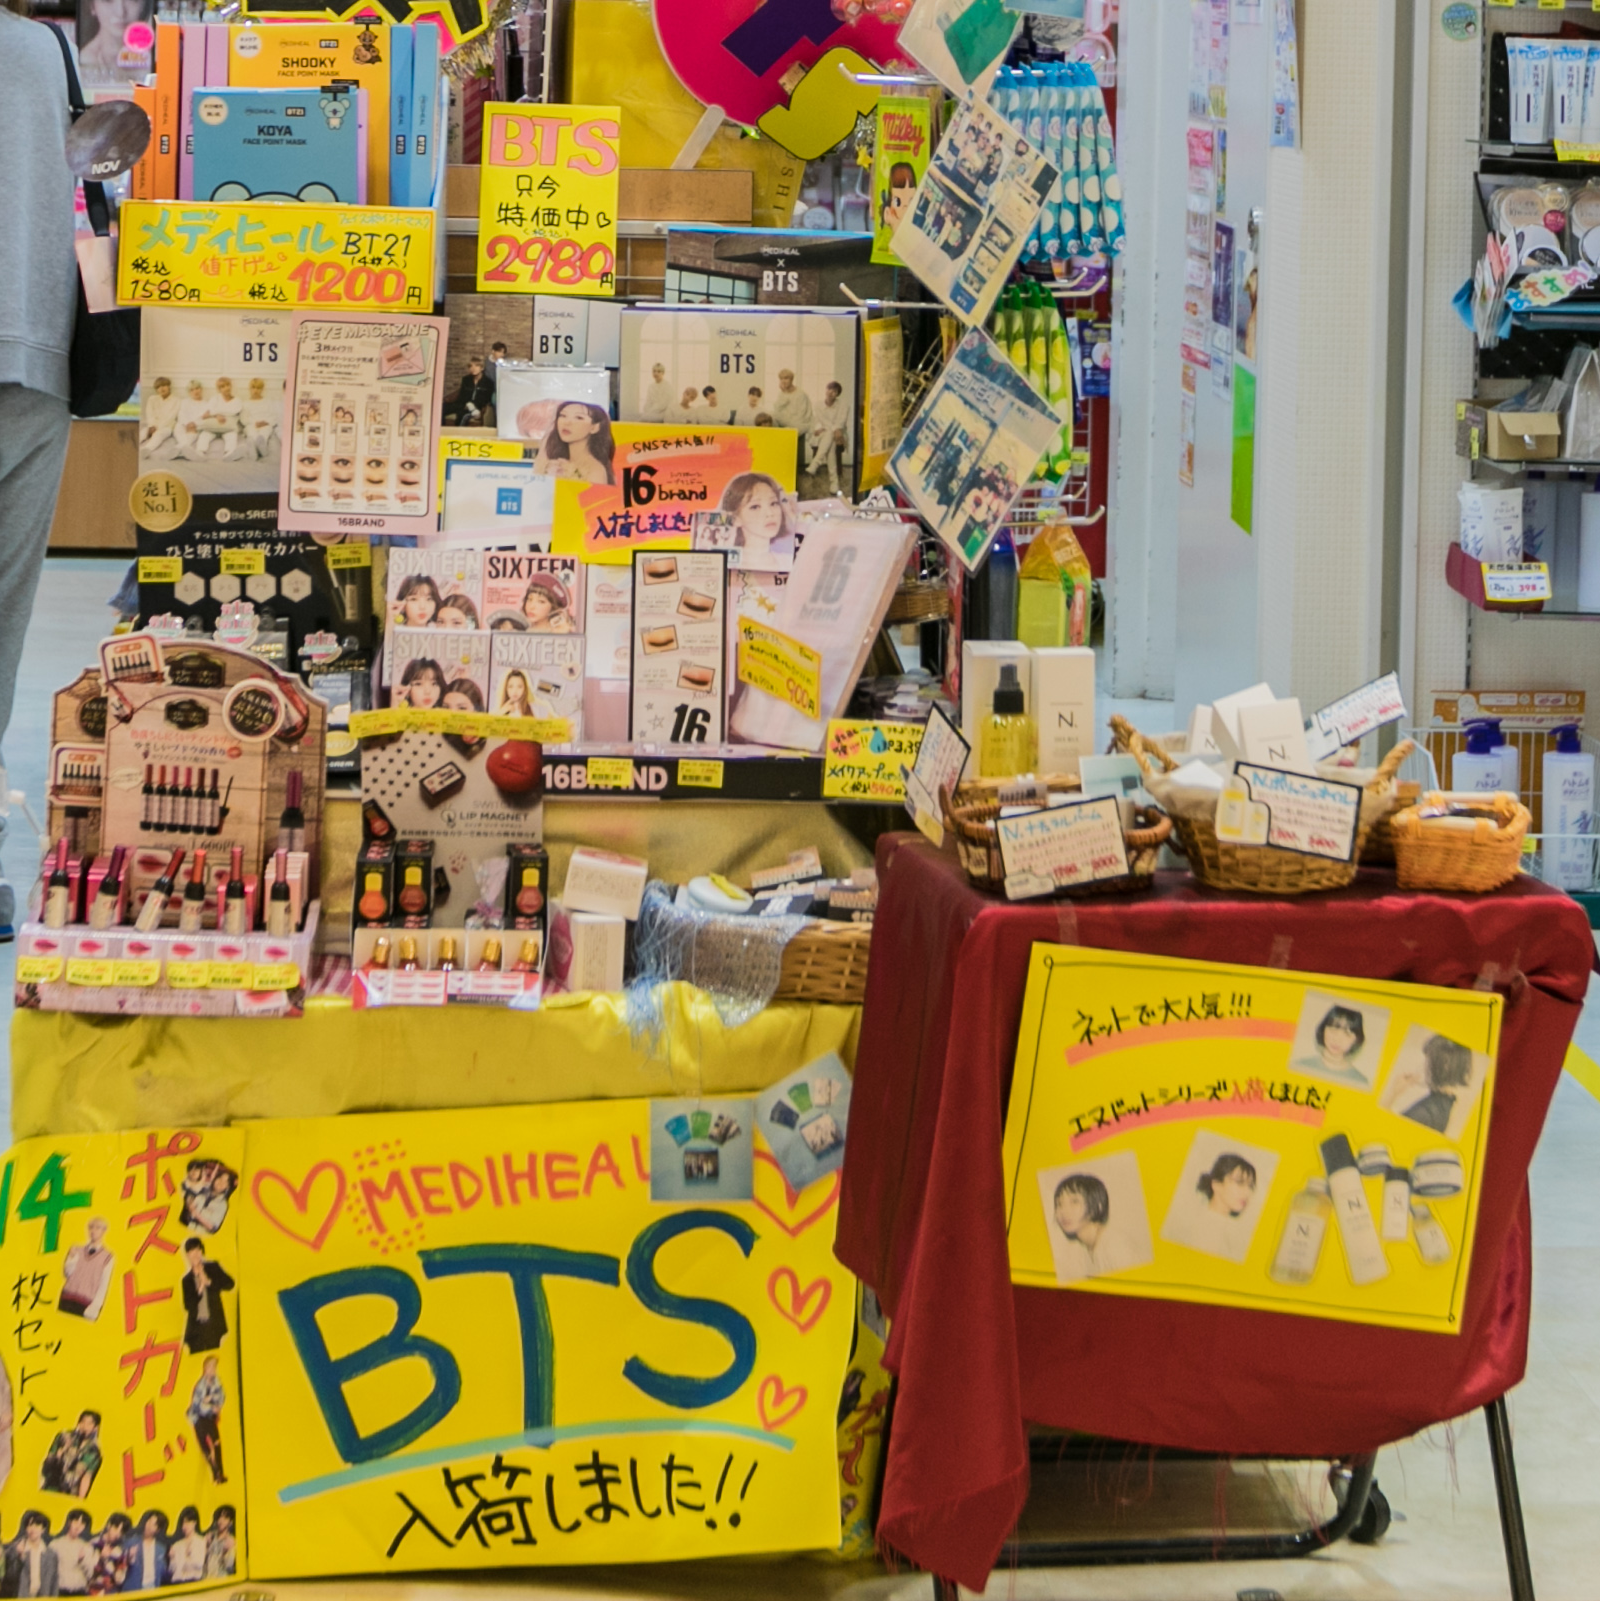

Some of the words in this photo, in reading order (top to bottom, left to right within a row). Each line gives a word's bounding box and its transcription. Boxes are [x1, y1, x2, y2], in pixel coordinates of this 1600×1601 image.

[281, 57, 337, 72] SHOOKY
[257, 125, 293, 138] KOYA
[882, 110, 924, 147] Milky
[488, 114, 620, 176] BTS
[515, 175, 560, 197] 只今
[497, 204, 593, 230] 特価中
[138, 210, 334, 254] メディヒール
[340, 232, 412, 257] BT21
[760, 246, 802, 257] MEDIHEAL
[131, 258, 171, 276] 税込
[130, 278, 201, 302] 1580円
[248, 282, 289, 303] 税込
[288, 261, 423, 305] 1200円
[762, 269, 799, 294] BTS
[344, 322, 432, 339] MAGAZINE
[717, 326, 758, 338] MEDIHEAL
[243, 341, 279, 363] BTS
[539, 334, 574, 355] BTS
[720, 353, 756, 375] BTS
[448, 439, 493, 458] BTS
[141, 481, 176, 498] 売上
[622, 464, 659, 509] 16
[657, 484, 708, 502] brand
[143, 497, 179, 514] No.1
[246, 509, 278, 521] SAEM
[337, 516, 386, 529] 16BRAND
[390, 550, 482, 577] SIXTEEN
[811, 545, 858, 604] 16
[396, 632, 488, 660] SIXTEEN
[497, 635, 581, 663] SIXTEEN
[670, 703, 712, 745] 16
[542, 763, 669, 793] 16BND
[459, 810, 476, 822] LIP
[479, 810, 530, 824] MAGNET
[119, 1131, 203, 1509] ポストカード
[277, 1208, 762, 1466] BTS
[386, 1450, 759, 1559] 入荷しました!!
